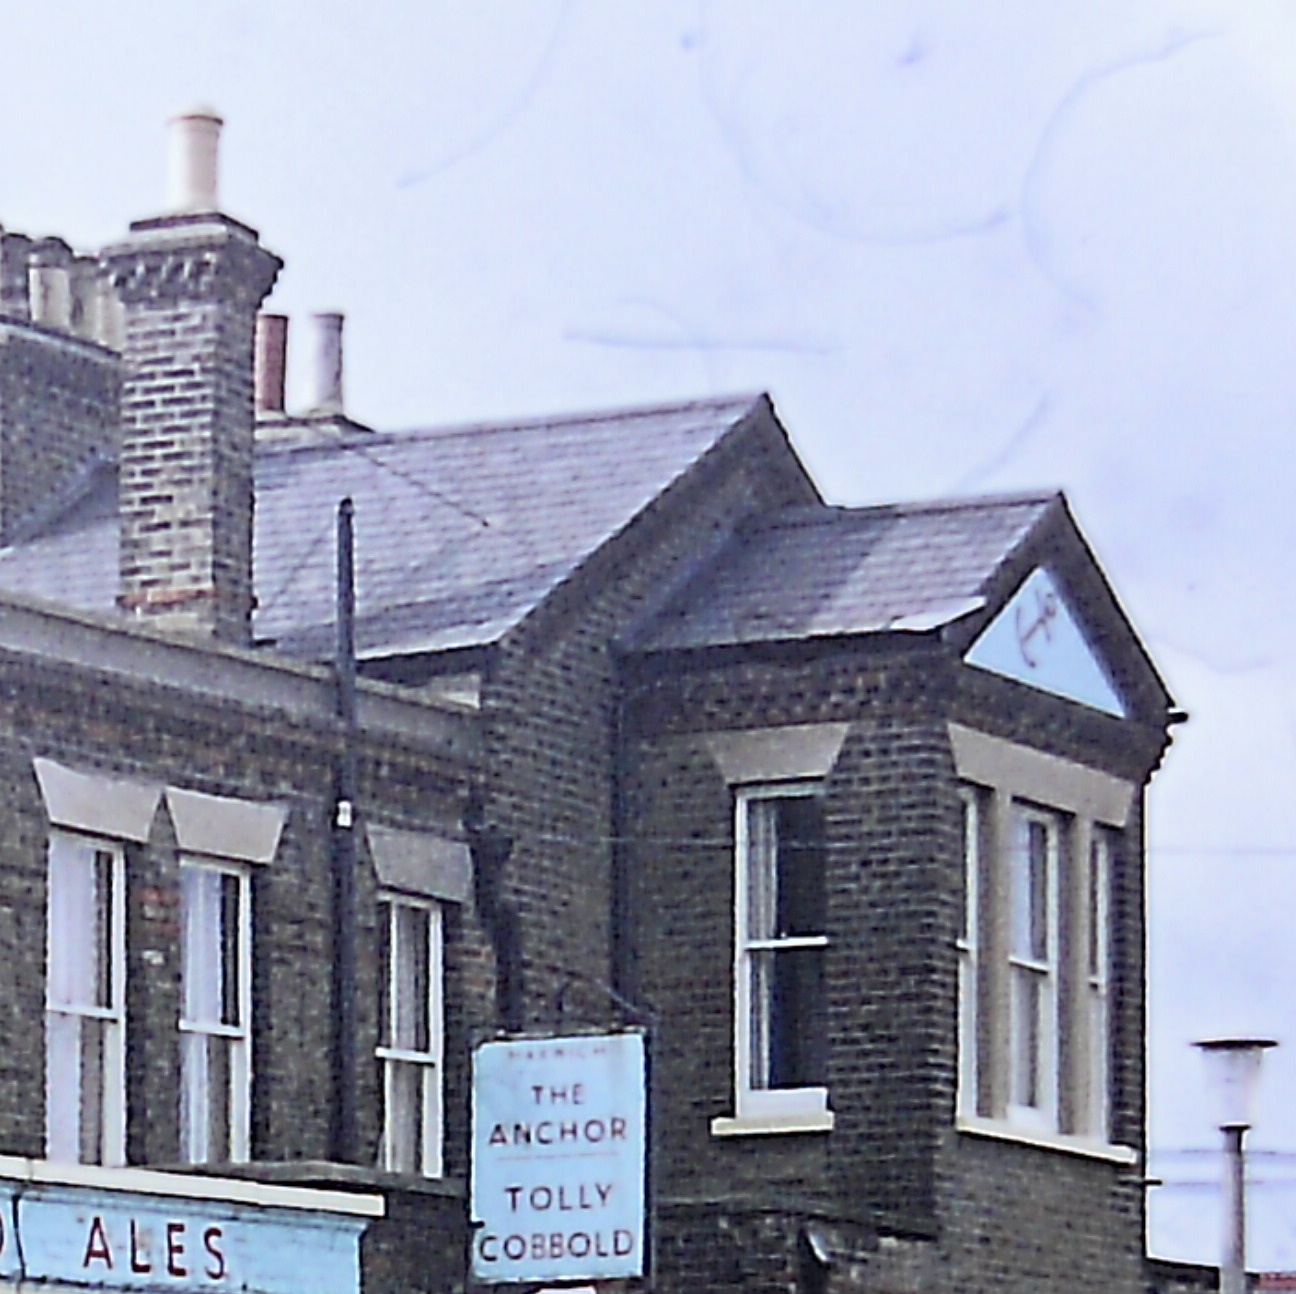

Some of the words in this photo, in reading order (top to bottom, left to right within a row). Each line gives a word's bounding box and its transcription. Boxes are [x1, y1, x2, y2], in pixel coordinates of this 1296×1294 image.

[531, 1084, 586, 1105] THE
[489, 1117, 627, 1146] ANCHOR
[504, 1183, 612, 1212] TOLLY
[82, 1216, 227, 1280] ALES
[479, 1229, 635, 1262] COBBOLD
